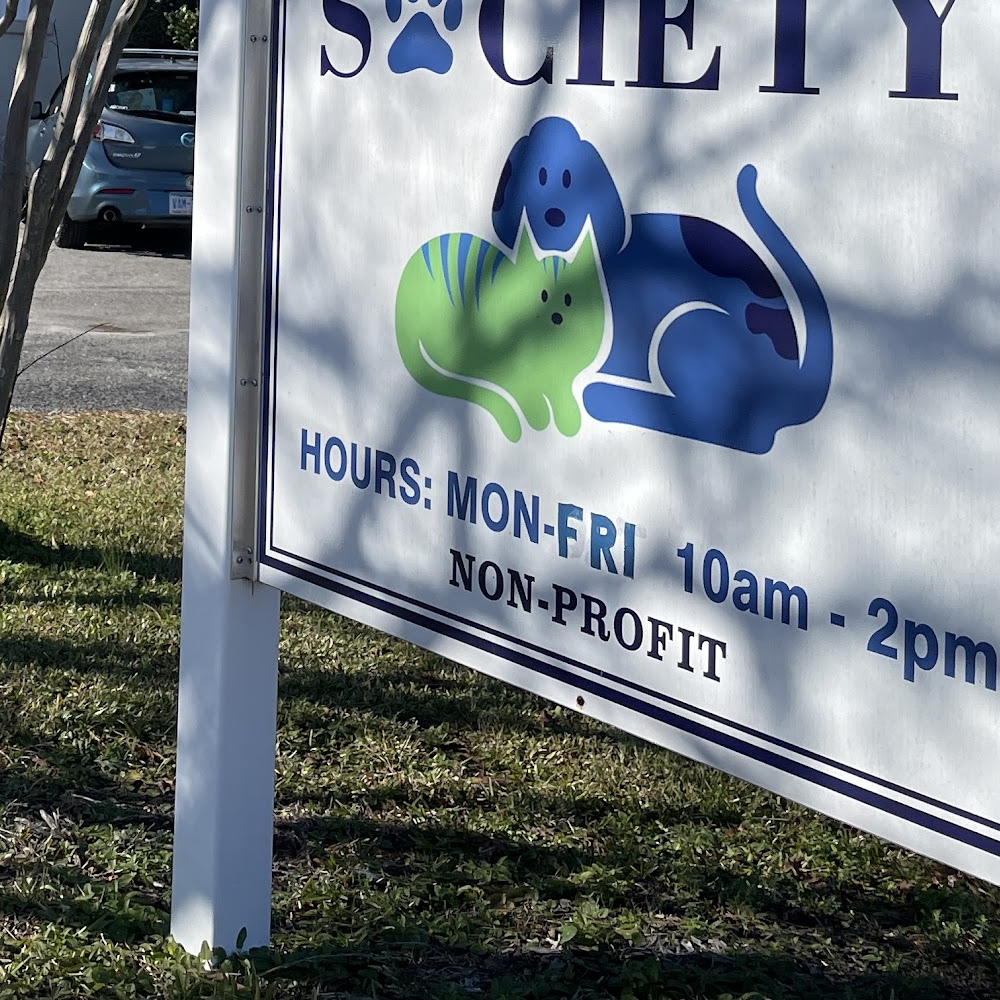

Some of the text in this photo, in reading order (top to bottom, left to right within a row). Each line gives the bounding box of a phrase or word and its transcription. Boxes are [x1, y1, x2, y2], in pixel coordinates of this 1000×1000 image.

[301, 429, 998, 692] HOURS: MON-FRI 10am - 2pm
[449, 548, 728, 684] NON-PROFIT
